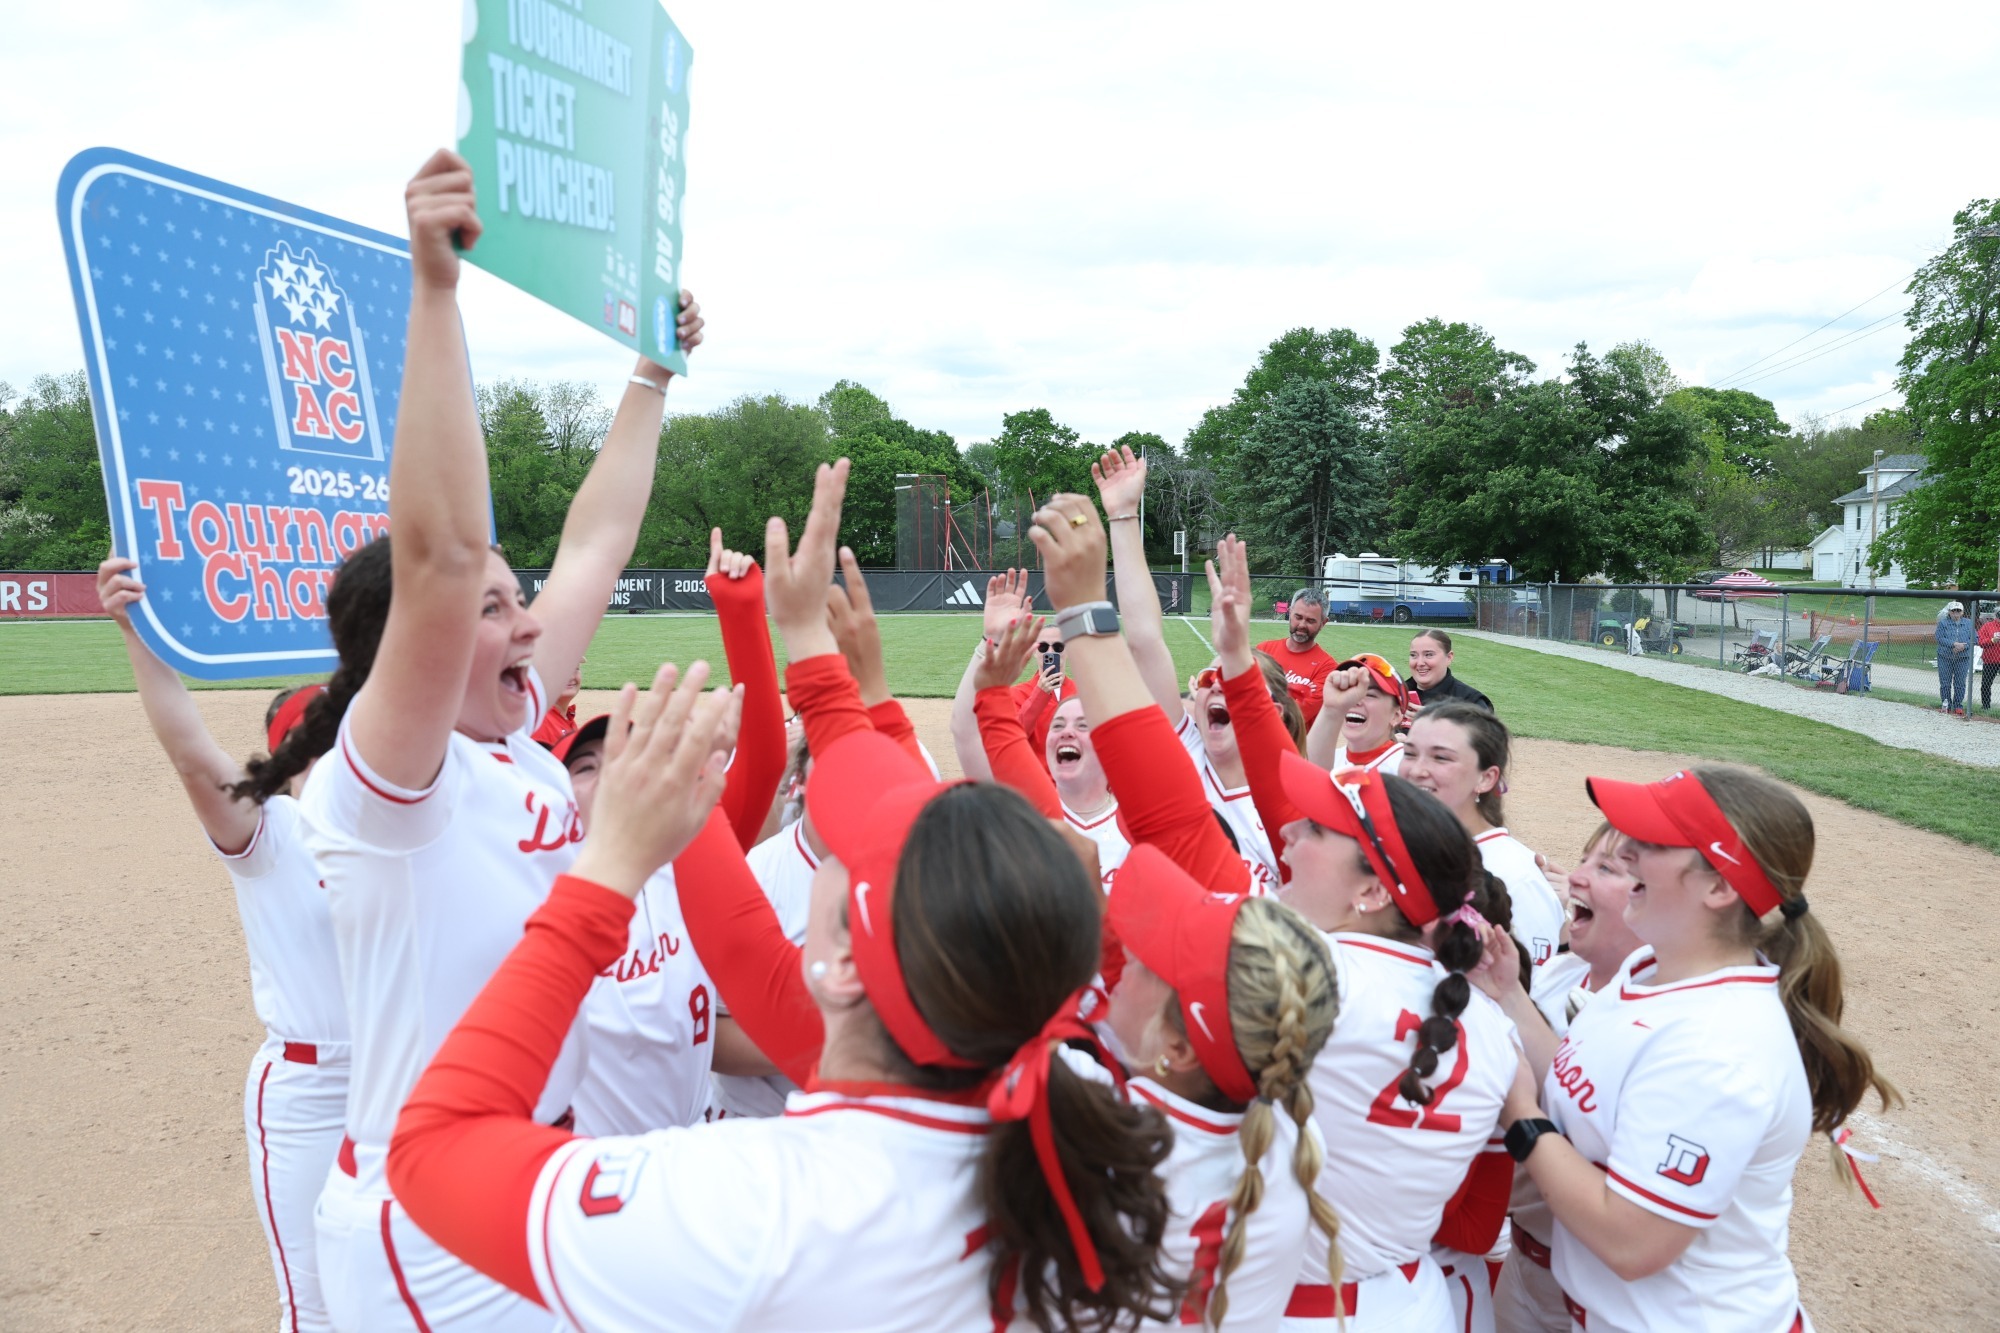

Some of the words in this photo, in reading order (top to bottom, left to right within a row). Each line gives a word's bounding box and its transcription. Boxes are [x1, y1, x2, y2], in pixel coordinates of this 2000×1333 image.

[507, 0, 632, 97] TOURNAMENT
[488, 52, 576, 151] TICKET
[496, 138, 616, 233] PUNCHED!
[657, 101, 679, 226] 25-26
[275, 325, 356, 390] NC
[292, 384, 365, 444] AC
[286, 466, 391, 502] 2025-26
[688, 983, 710, 1047] 8
[1656, 1133, 1711, 1187] D
